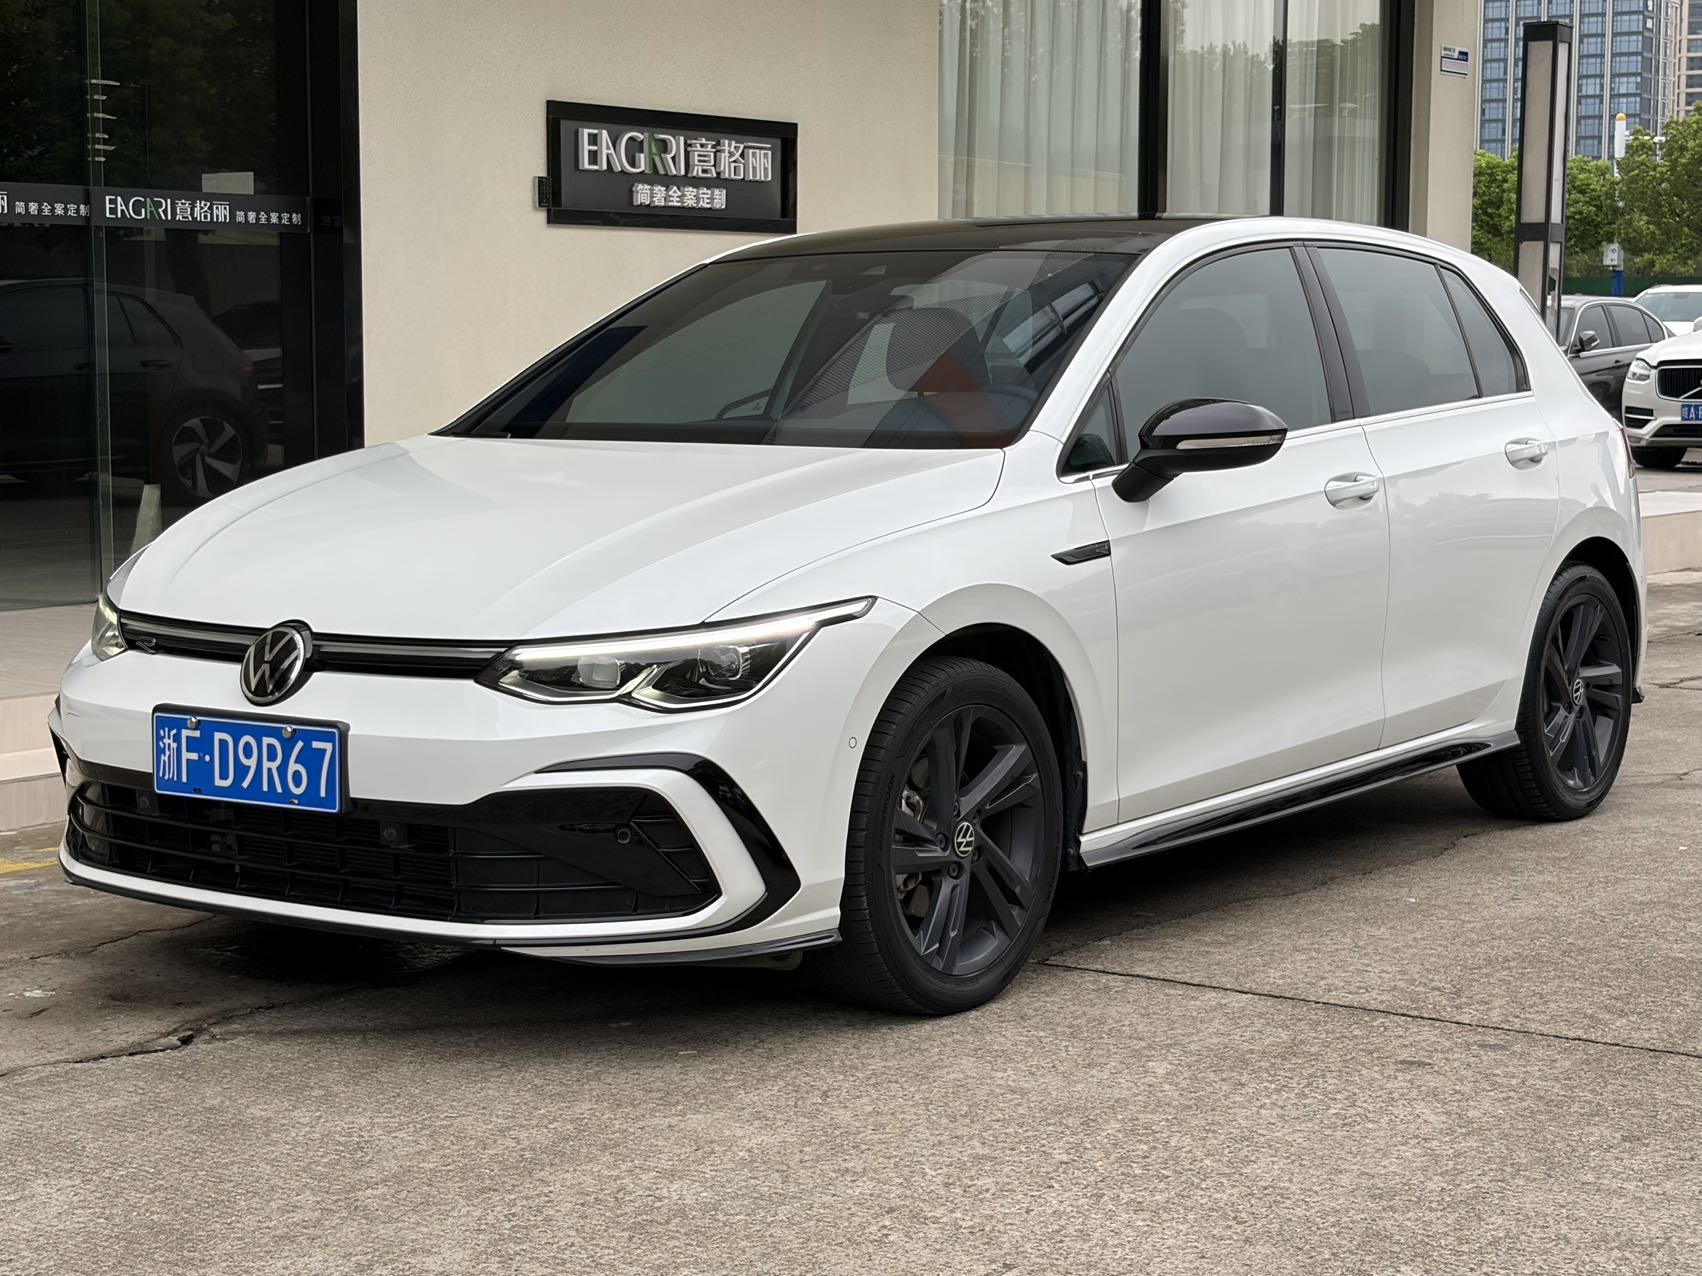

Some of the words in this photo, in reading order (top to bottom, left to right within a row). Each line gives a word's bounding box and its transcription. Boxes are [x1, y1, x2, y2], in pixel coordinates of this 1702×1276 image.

[687, 137, 773, 182] 意格丽
[14, 201, 90, 217] 简奢全案定制
[632, 182, 726, 209] 简奢全案定制
[175, 199, 230, 223] 意格丽
[236, 211, 302, 226] 简奢全案定制
[159, 727, 333, 798] 浙F·D9R67
